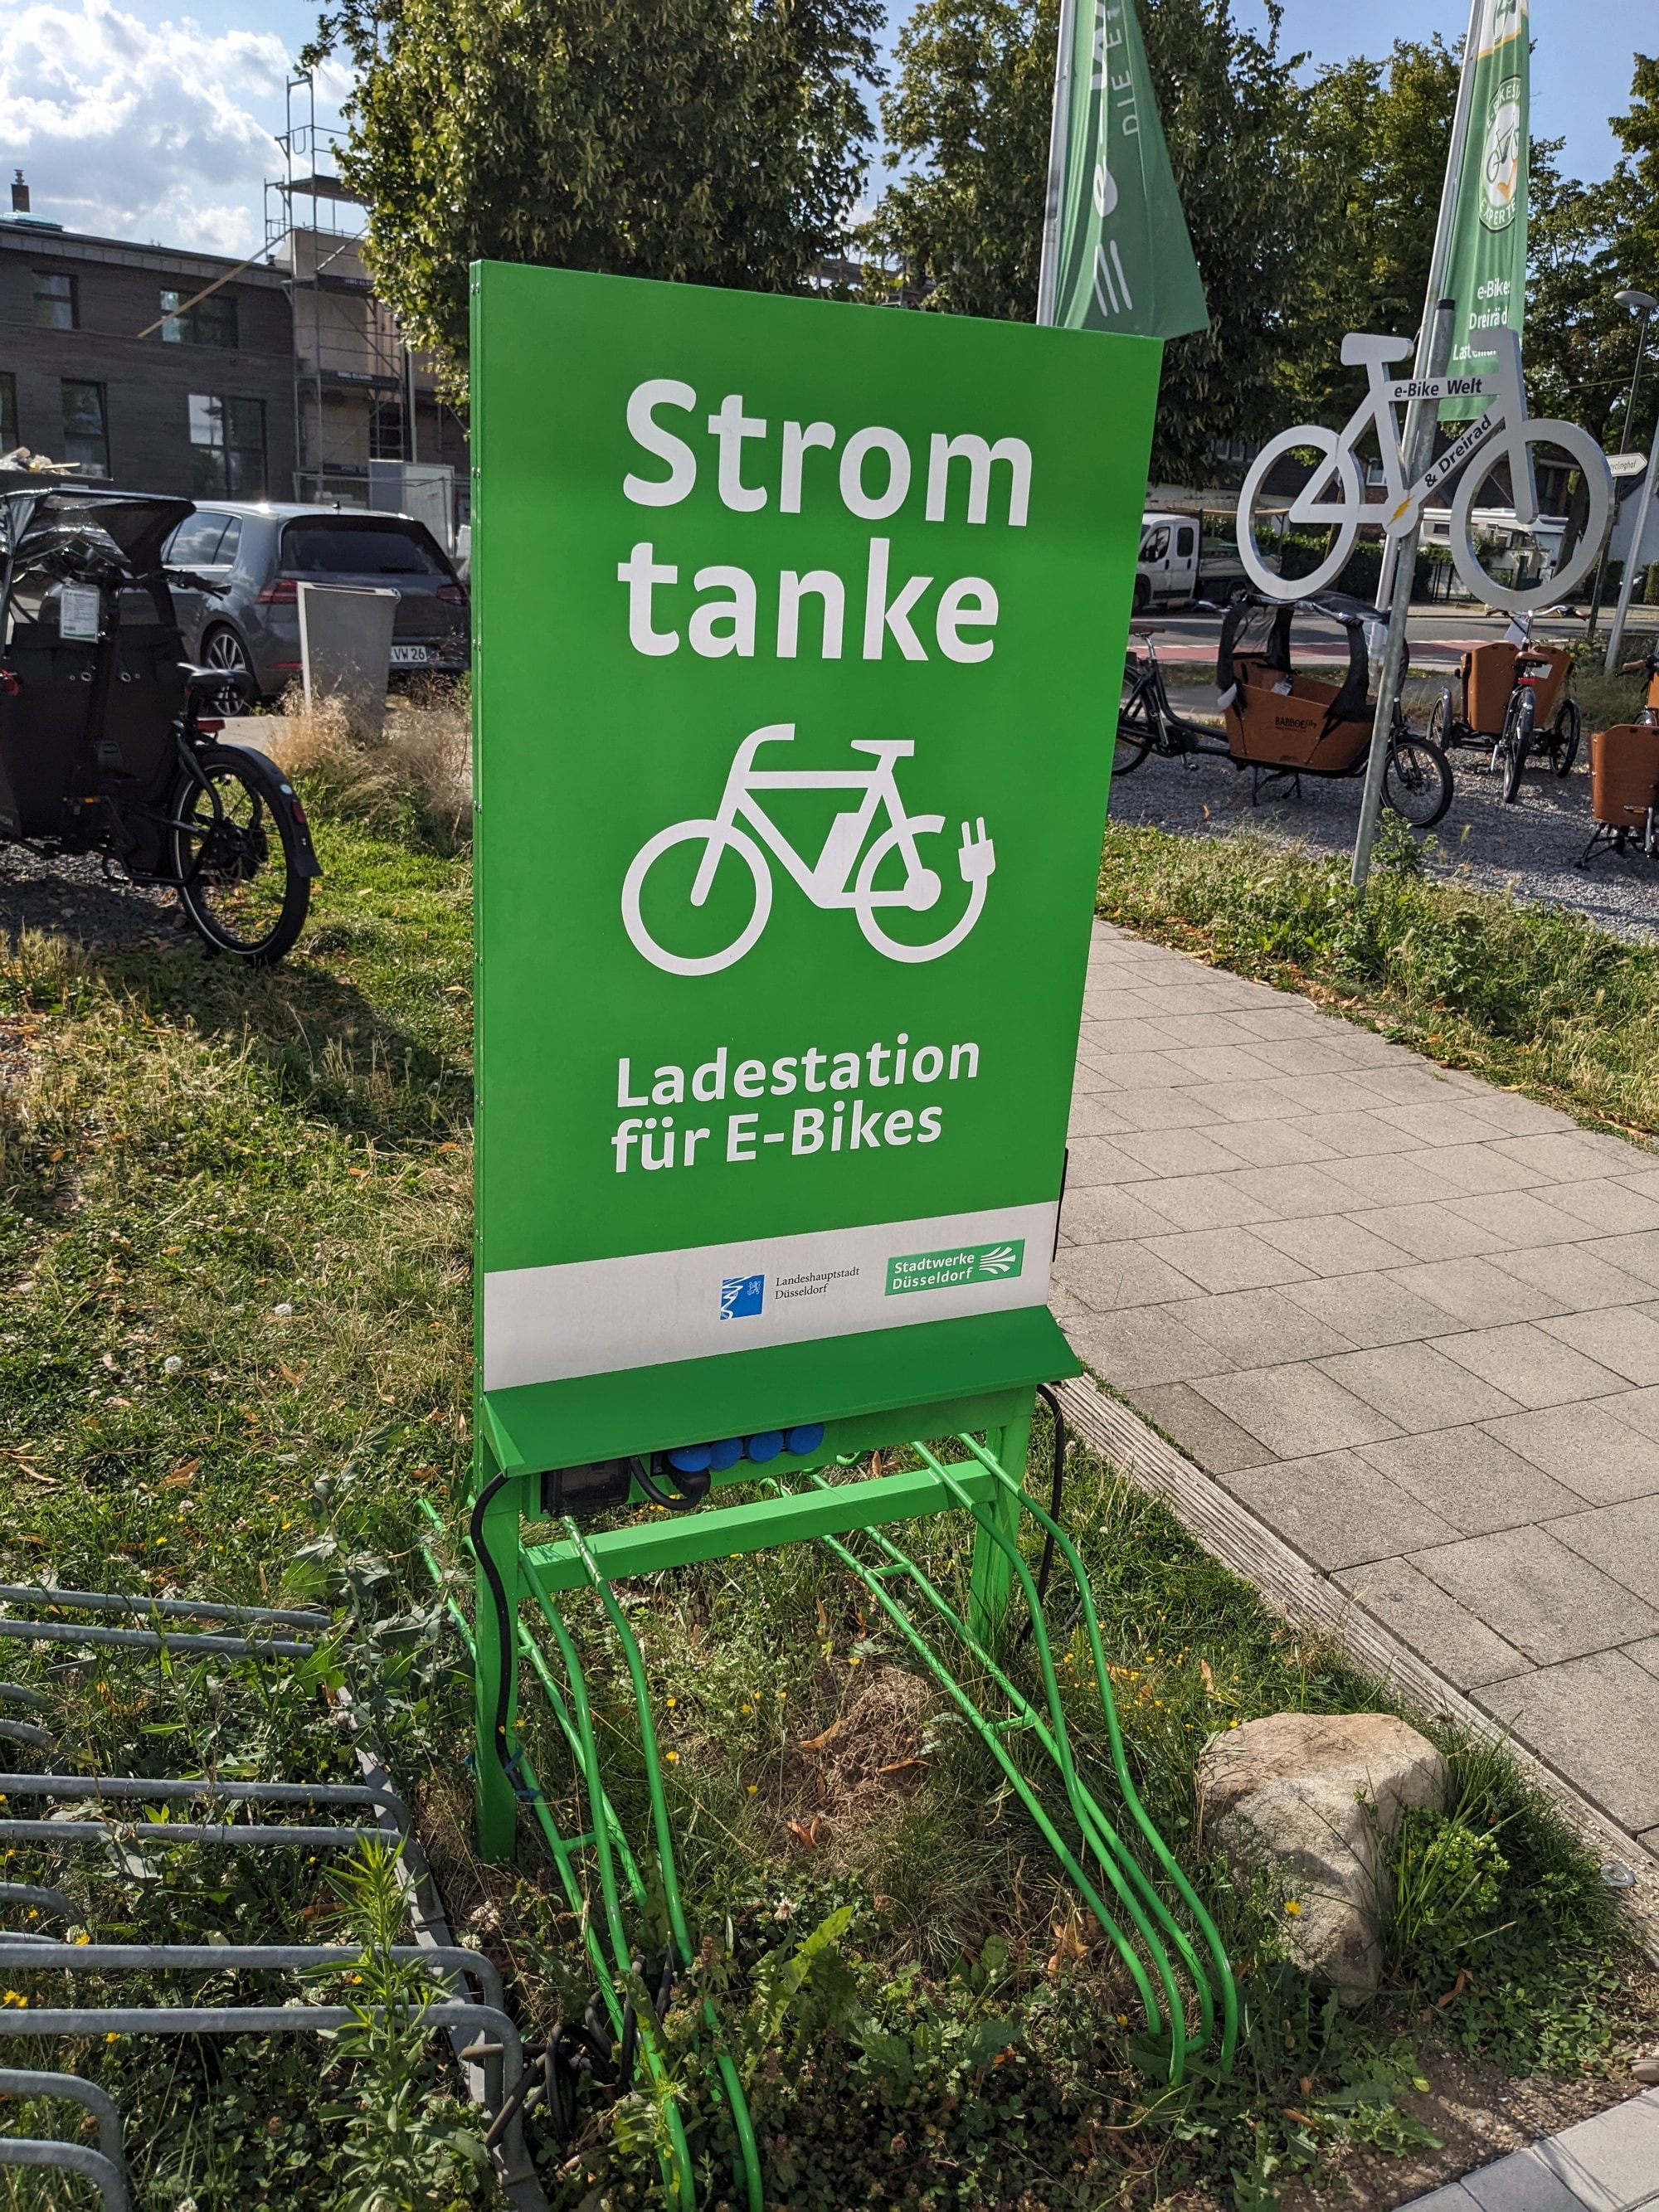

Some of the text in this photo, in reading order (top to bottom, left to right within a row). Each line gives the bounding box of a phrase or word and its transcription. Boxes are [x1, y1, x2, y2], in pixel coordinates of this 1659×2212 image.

[1111, 70, 1139, 136] DIE
[1479, 197, 1516, 226] EXPERTE
[1468, 306, 1508, 330] Dreiräd
[1394, 377, 1483, 398] e-Bike Welt
[622, 378, 1033, 527] Strom
[1424, 414, 1492, 488] & Dreirad
[1610, 459, 1637, 473] yclinghof
[617, 537, 999, 664] tanke
[393, 648, 426, 661] VW 26
[616, 1033, 980, 1108] Ladestation
[611, 1099, 943, 1174] für E-Bikes
[894, 1252, 975, 1274] Stadtwerke
[776, 1266, 860, 1286] Landeshauptstadt
[893, 1267, 973, 1290] Düsseldorf
[775, 1283, 829, 1300] Düsseldorf
